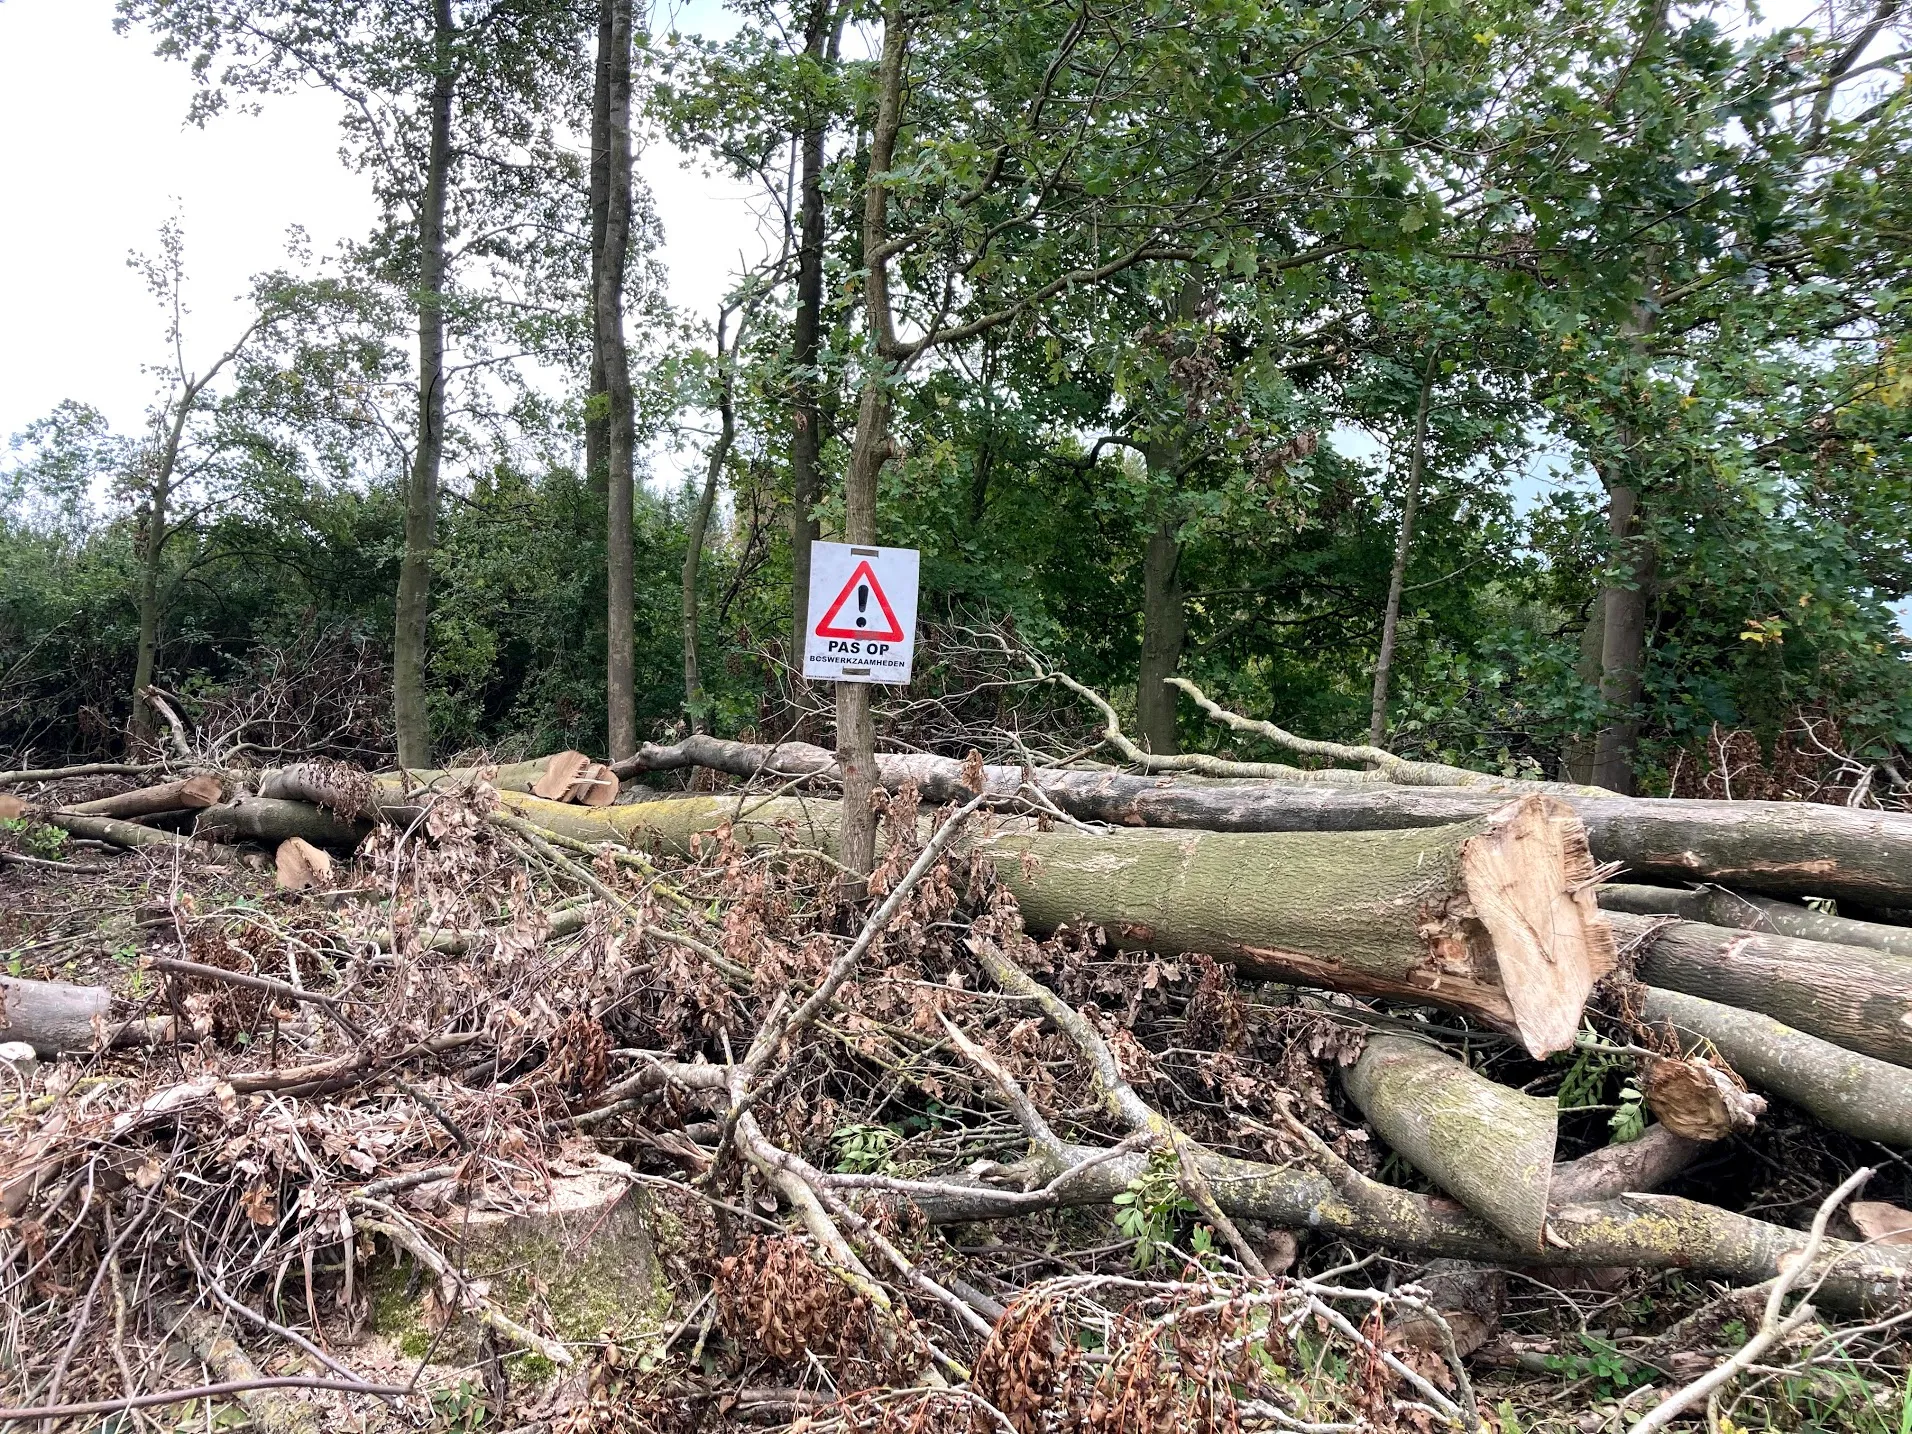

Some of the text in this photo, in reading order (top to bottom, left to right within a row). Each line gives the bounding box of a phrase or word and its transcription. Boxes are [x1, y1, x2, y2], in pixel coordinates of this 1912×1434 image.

[828, 640, 890, 655] PAS OP
[809, 655, 905, 667] BOSWERKZAAMHEDEN
